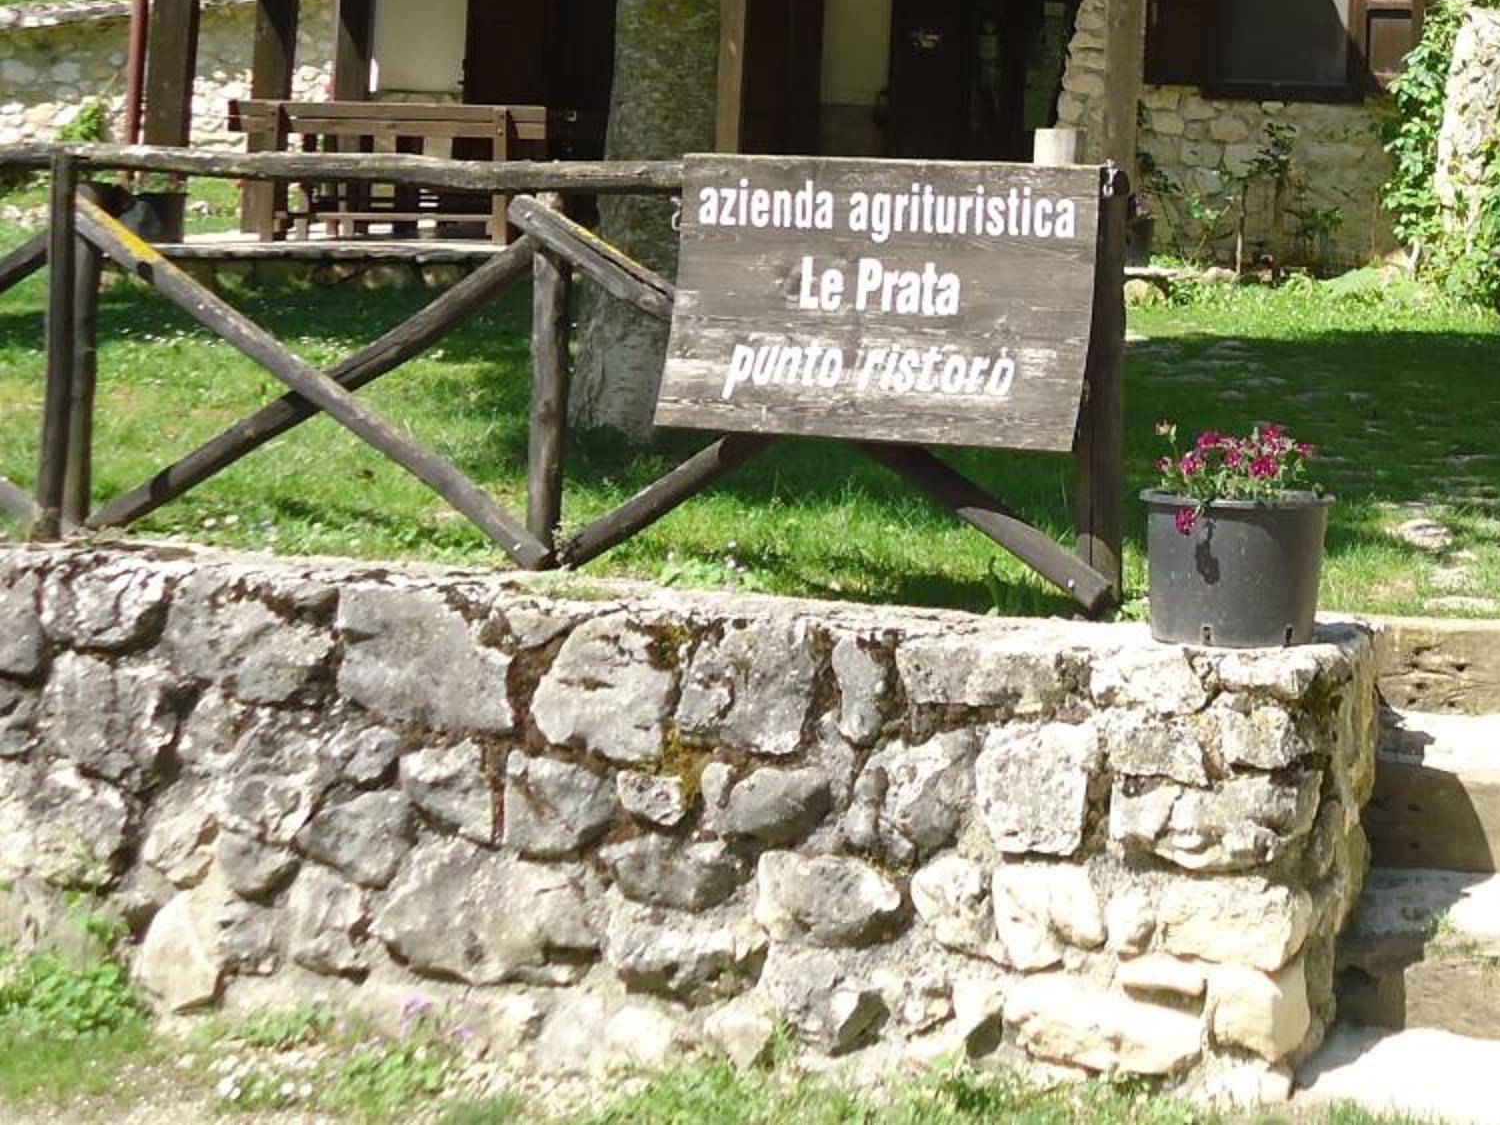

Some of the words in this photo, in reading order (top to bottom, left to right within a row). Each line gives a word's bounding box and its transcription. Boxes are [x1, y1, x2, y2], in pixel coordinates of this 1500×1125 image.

[699, 179, 833, 230] azienda
[849, 183, 1076, 242] agrituristica
[799, 256, 843, 311] Le
[855, 256, 961, 316] Prata
[722, 339, 843, 399] punto
[857, 343, 1016, 396] ristoro
